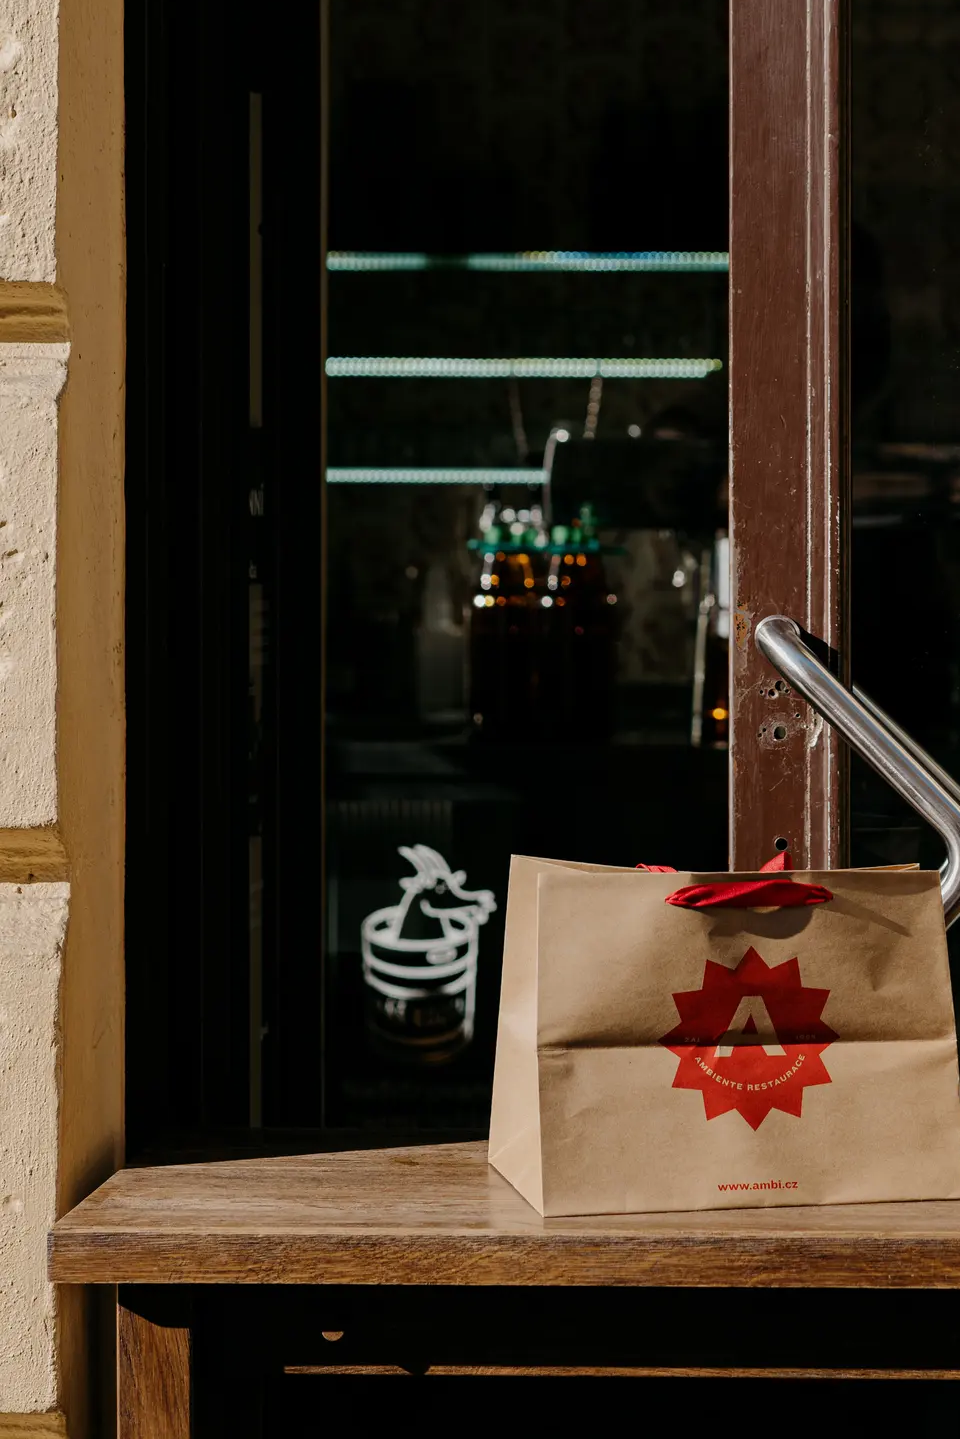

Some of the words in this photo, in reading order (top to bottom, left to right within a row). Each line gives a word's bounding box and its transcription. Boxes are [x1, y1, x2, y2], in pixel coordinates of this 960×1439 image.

[714, 995, 787, 1058] A
[694, 1055, 743, 1091] AMBIENTE
[746, 1053, 807, 1092] RESTAURACE
[717, 1180, 798, 1192] www.ambi.cz
